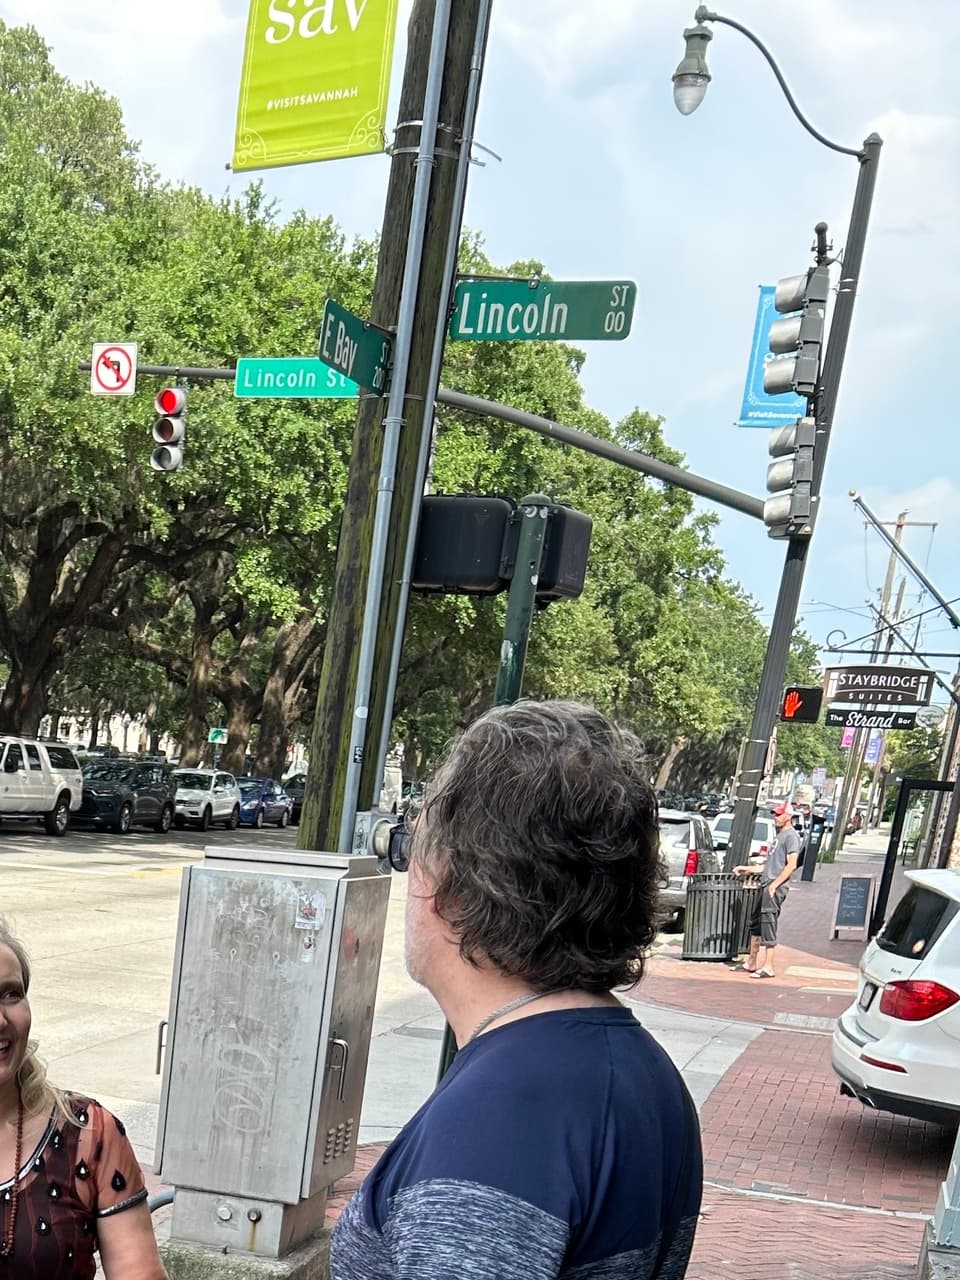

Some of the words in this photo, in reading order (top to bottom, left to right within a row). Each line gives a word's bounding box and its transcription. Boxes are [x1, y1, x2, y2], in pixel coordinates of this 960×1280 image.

[266, 87, 358, 111] #VISITSAVANNAH
[458, 292, 569, 334] Lincoln
[610, 285, 630, 307] ST
[333, 320, 358, 378] Bay
[243, 368, 317, 388] Lincoln
[326, 369, 347, 388] St
[838, 674, 918, 688] STAYBRIDGE
[848, 693, 902, 701] SUITES
[845, 711, 897, 728] Strand
[898, 717, 912, 725] Bar
